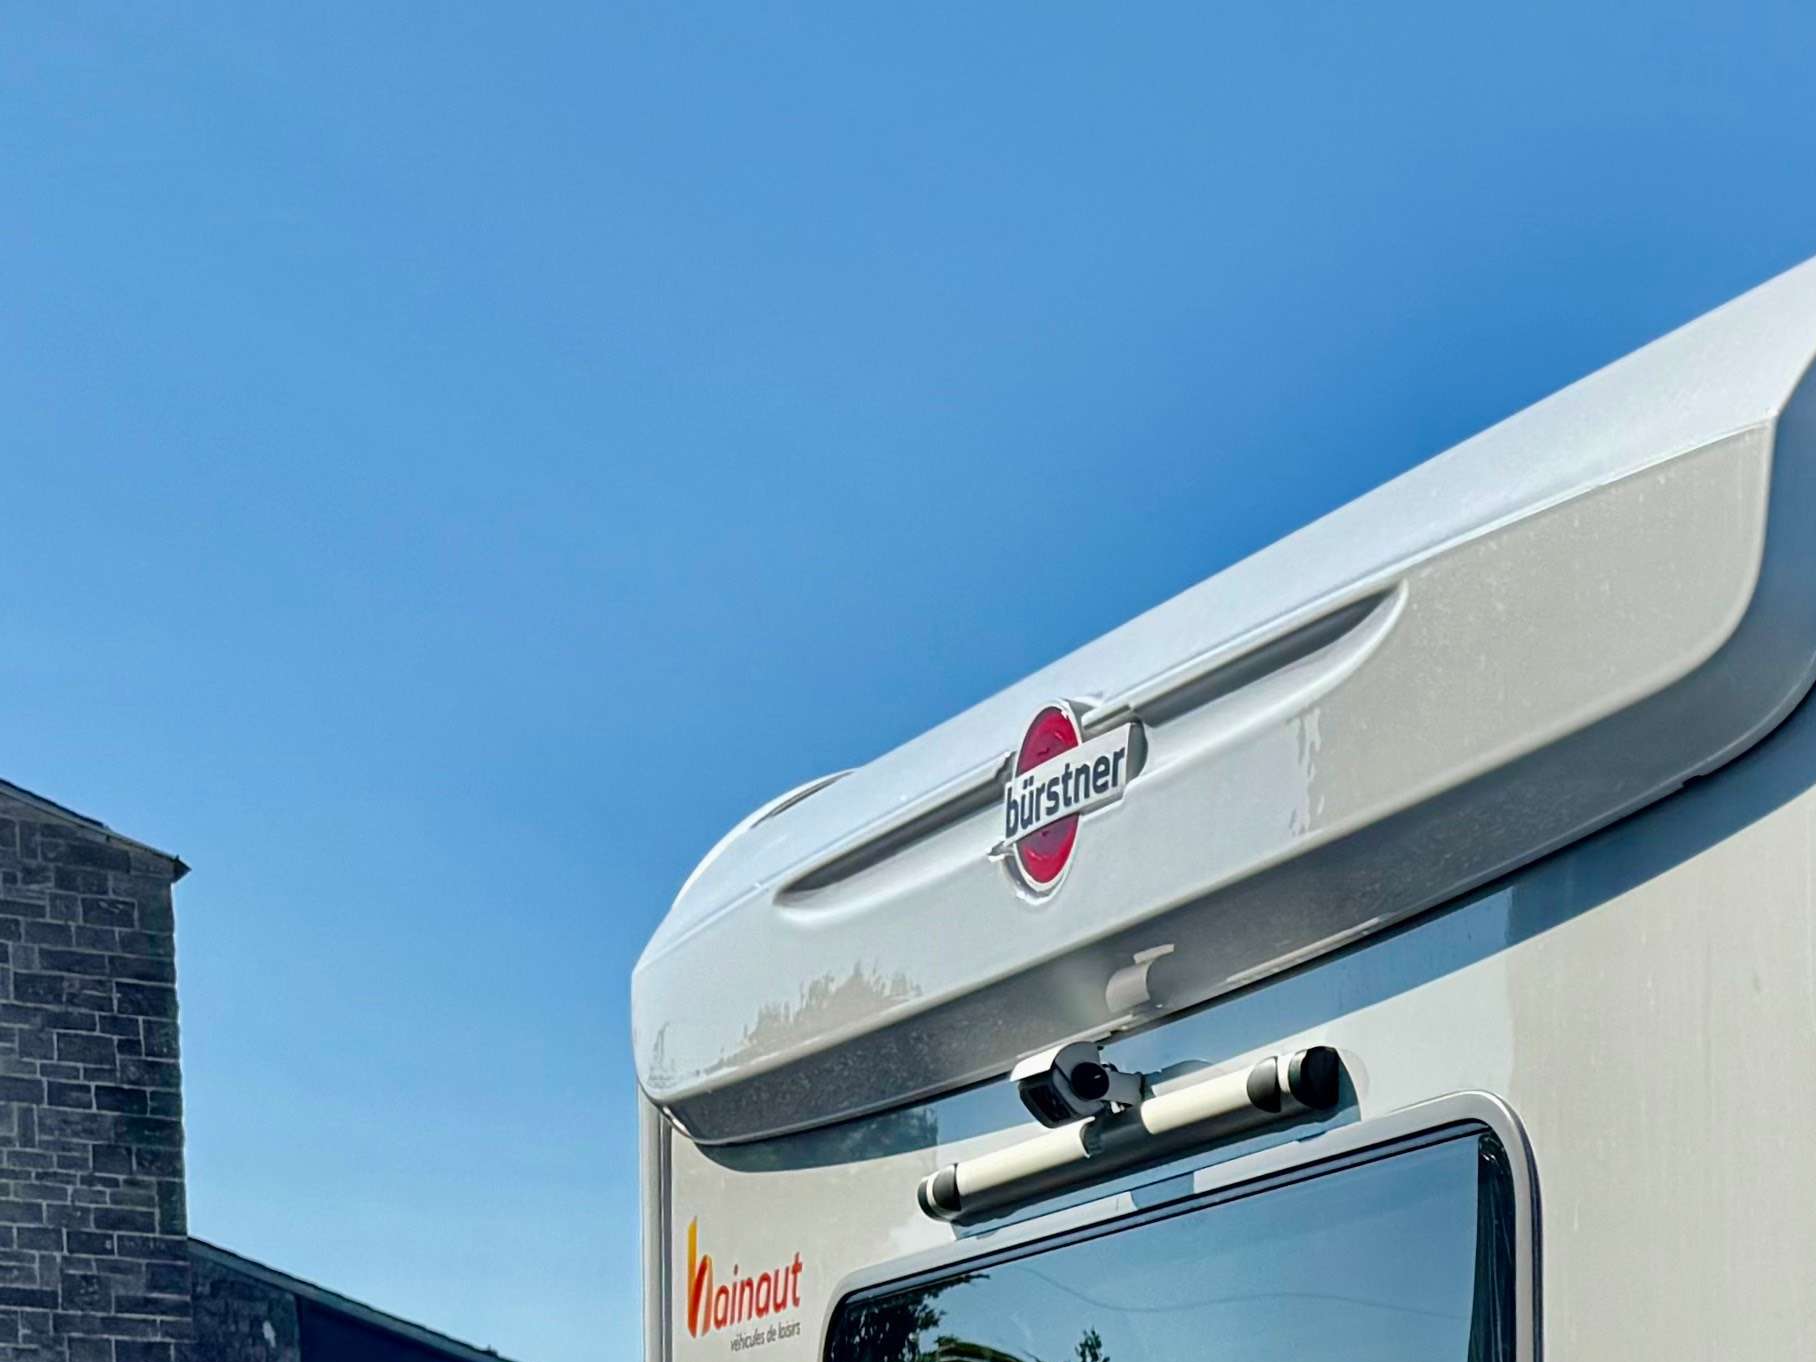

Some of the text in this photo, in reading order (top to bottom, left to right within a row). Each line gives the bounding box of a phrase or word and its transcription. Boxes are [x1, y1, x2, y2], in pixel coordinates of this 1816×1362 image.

[1006, 747, 1126, 838] bürstner
[687, 1216, 803, 1338] hainaut
[766, 1324, 777, 1343] de
